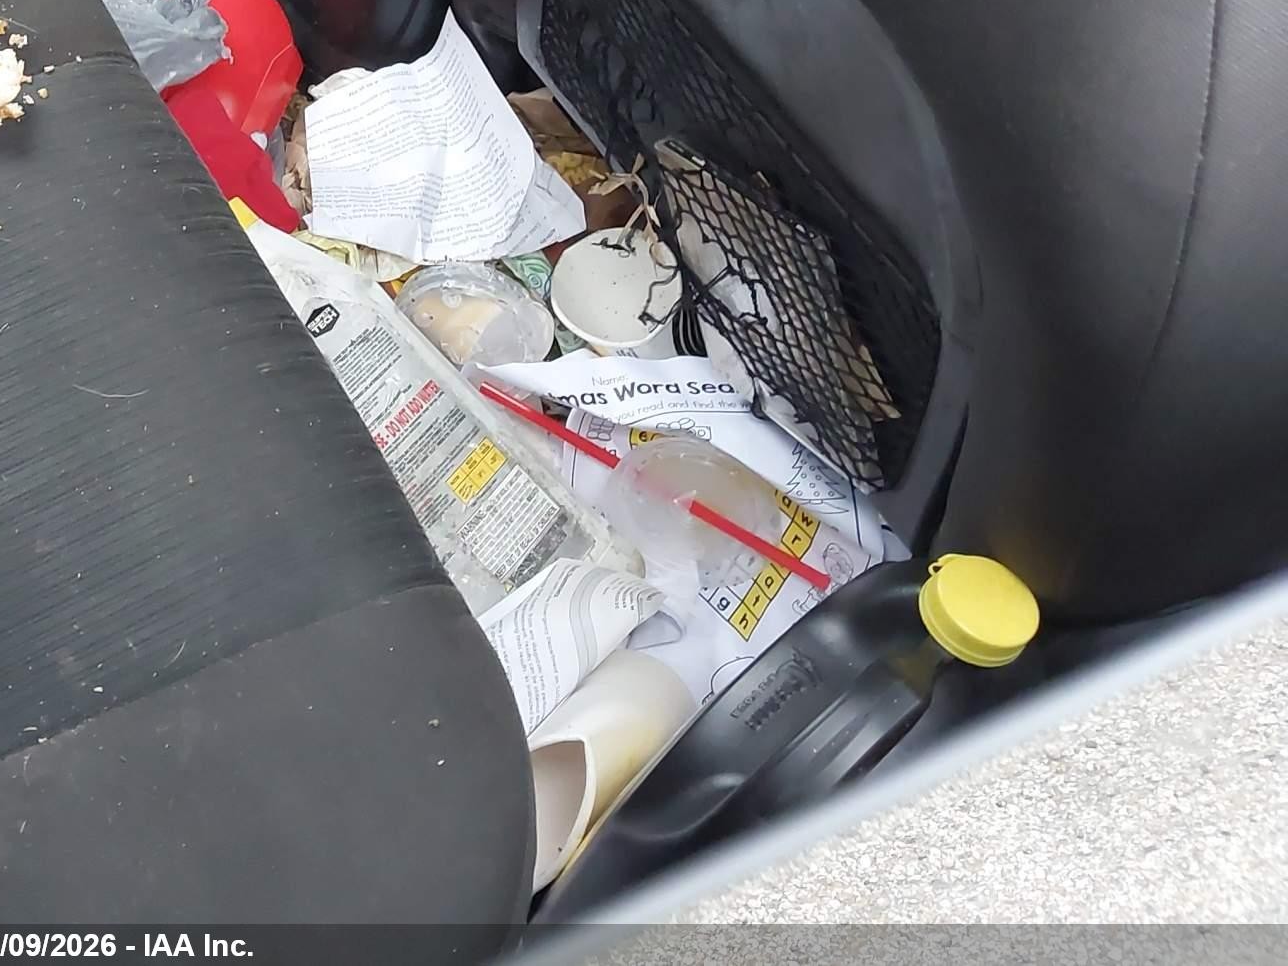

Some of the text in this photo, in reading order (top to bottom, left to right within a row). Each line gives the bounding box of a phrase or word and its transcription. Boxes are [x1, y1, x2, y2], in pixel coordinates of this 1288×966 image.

[311, 310, 337, 335] TECH
[545, 381, 738, 407] mas Word Sea
[383, 418, 401, 438] DO
[393, 407, 413, 428] NOT
[404, 395, 424, 416] ADD
[637, 400, 665, 414] read
[716, 596, 730, 611] g
